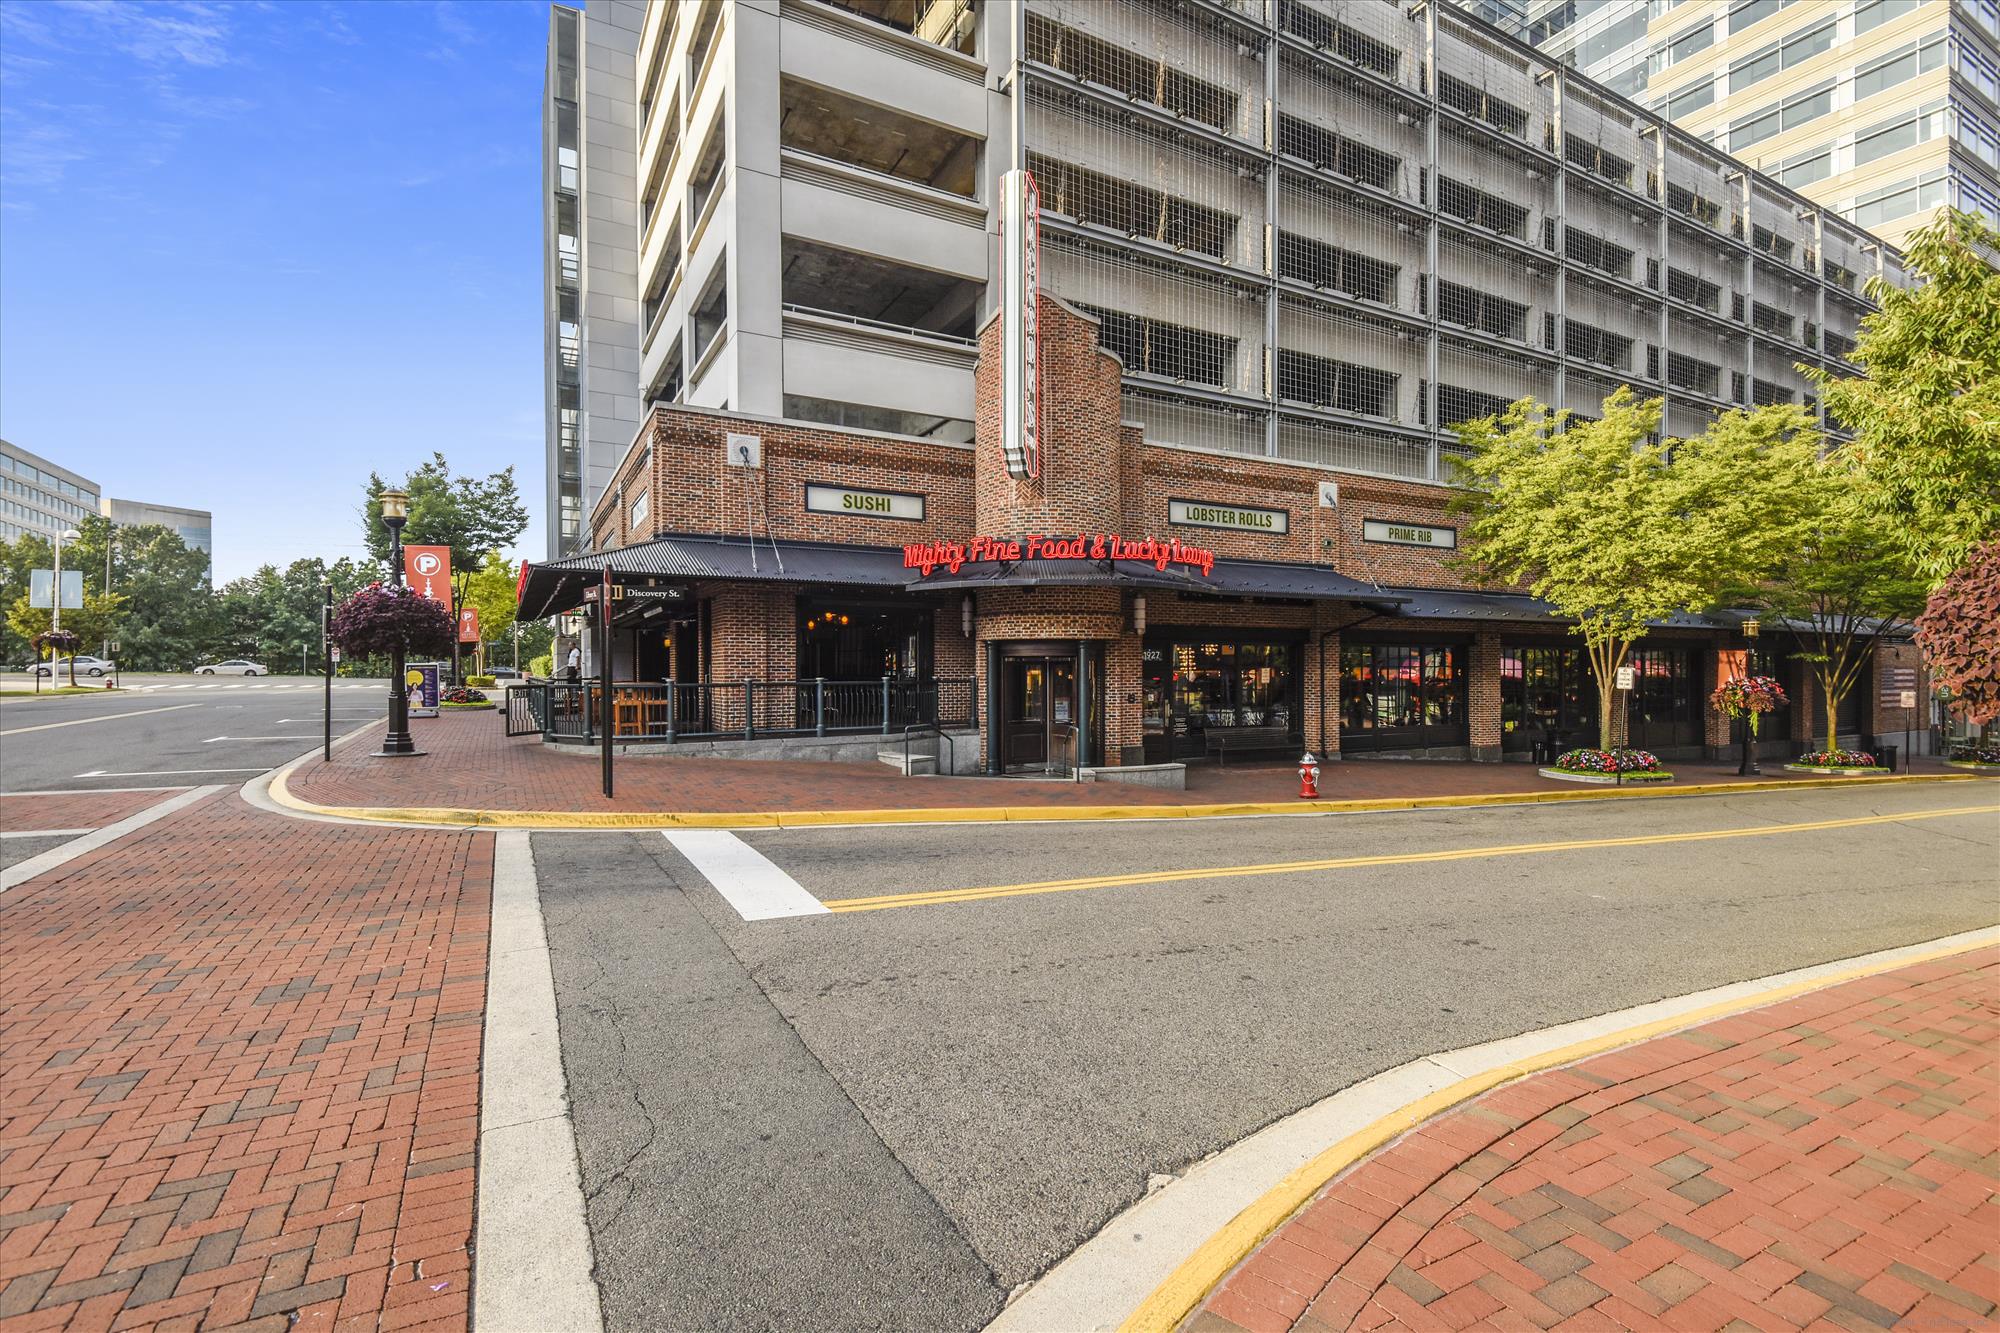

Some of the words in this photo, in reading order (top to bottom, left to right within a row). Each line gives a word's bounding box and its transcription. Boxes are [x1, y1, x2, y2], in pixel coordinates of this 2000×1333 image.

[843, 494, 891, 512] SUSHI
[1186, 506, 1236, 524] LOBSTER
[1239, 512, 1272, 528] ROLLS
[1388, 527, 1415, 541] PRIME
[1418, 530, 1432, 543] RIB
[903, 541, 966, 576] Mighty
[970, 536, 1020, 562] Fine
[1027, 533, 1086, 559] Food
[1090, 533, 1106, 559] &
[1109, 535, 1170, 572] Lucky
[419, 556, 437, 573] P
[626, 588, 668, 599] Discovery
[668, 589, 680, 598] St.
[514, 689, 528, 698] EXIT
